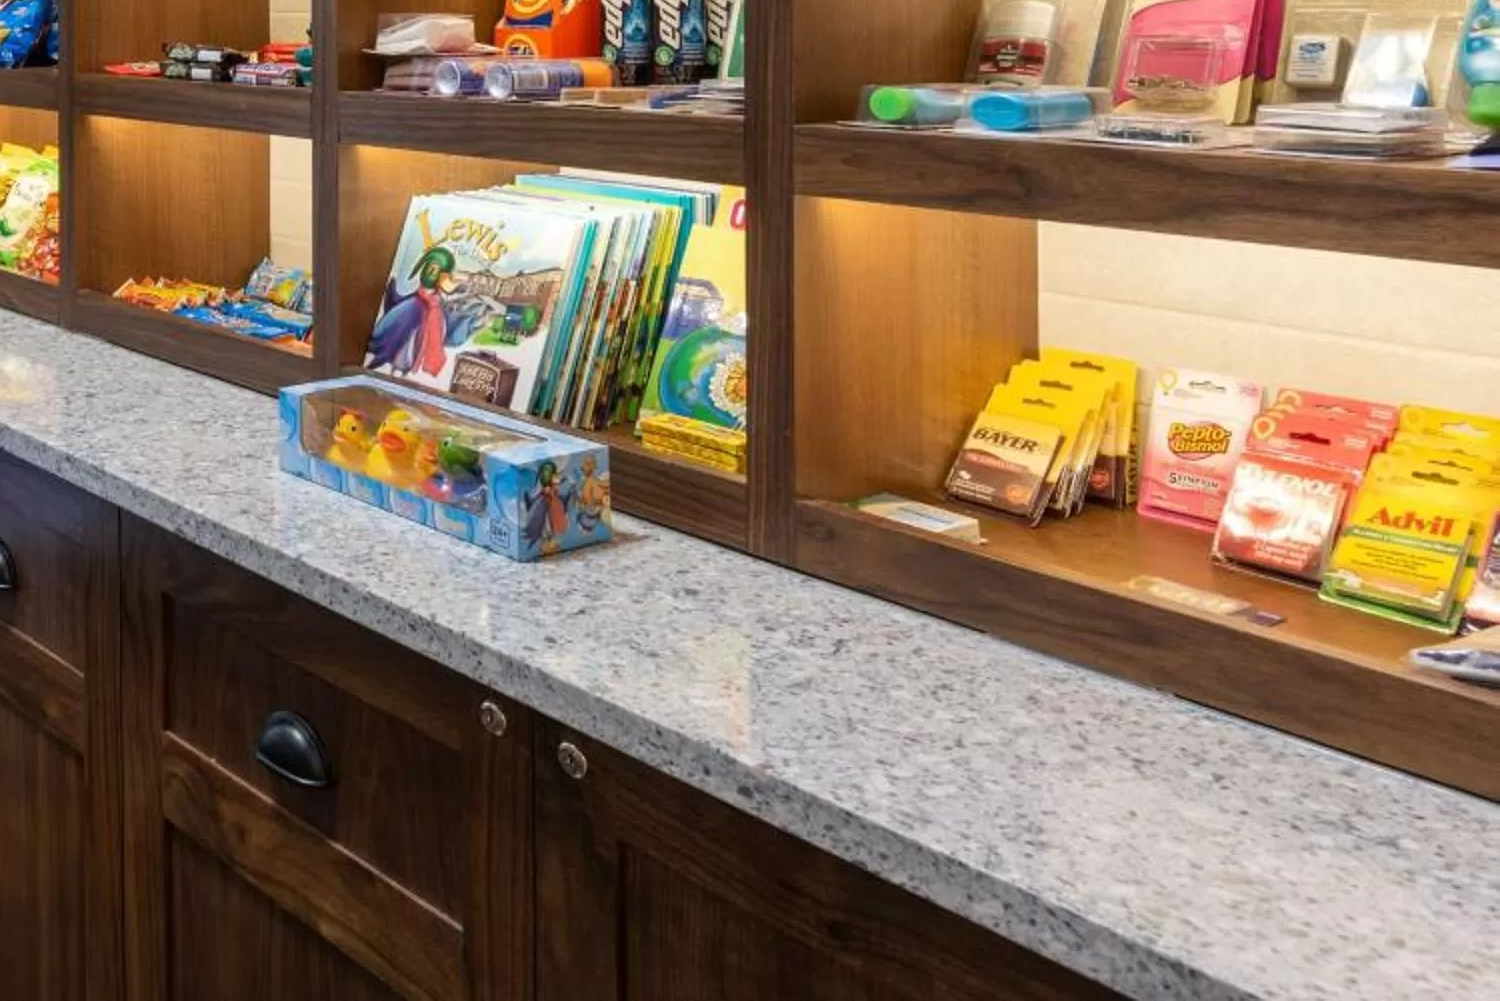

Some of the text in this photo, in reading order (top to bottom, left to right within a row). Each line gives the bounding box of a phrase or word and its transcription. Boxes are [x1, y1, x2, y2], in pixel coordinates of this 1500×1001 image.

[415, 208, 510, 263] Lewis
[972, 426, 1039, 453] BAYER
[1366, 506, 1456, 537] Advil
